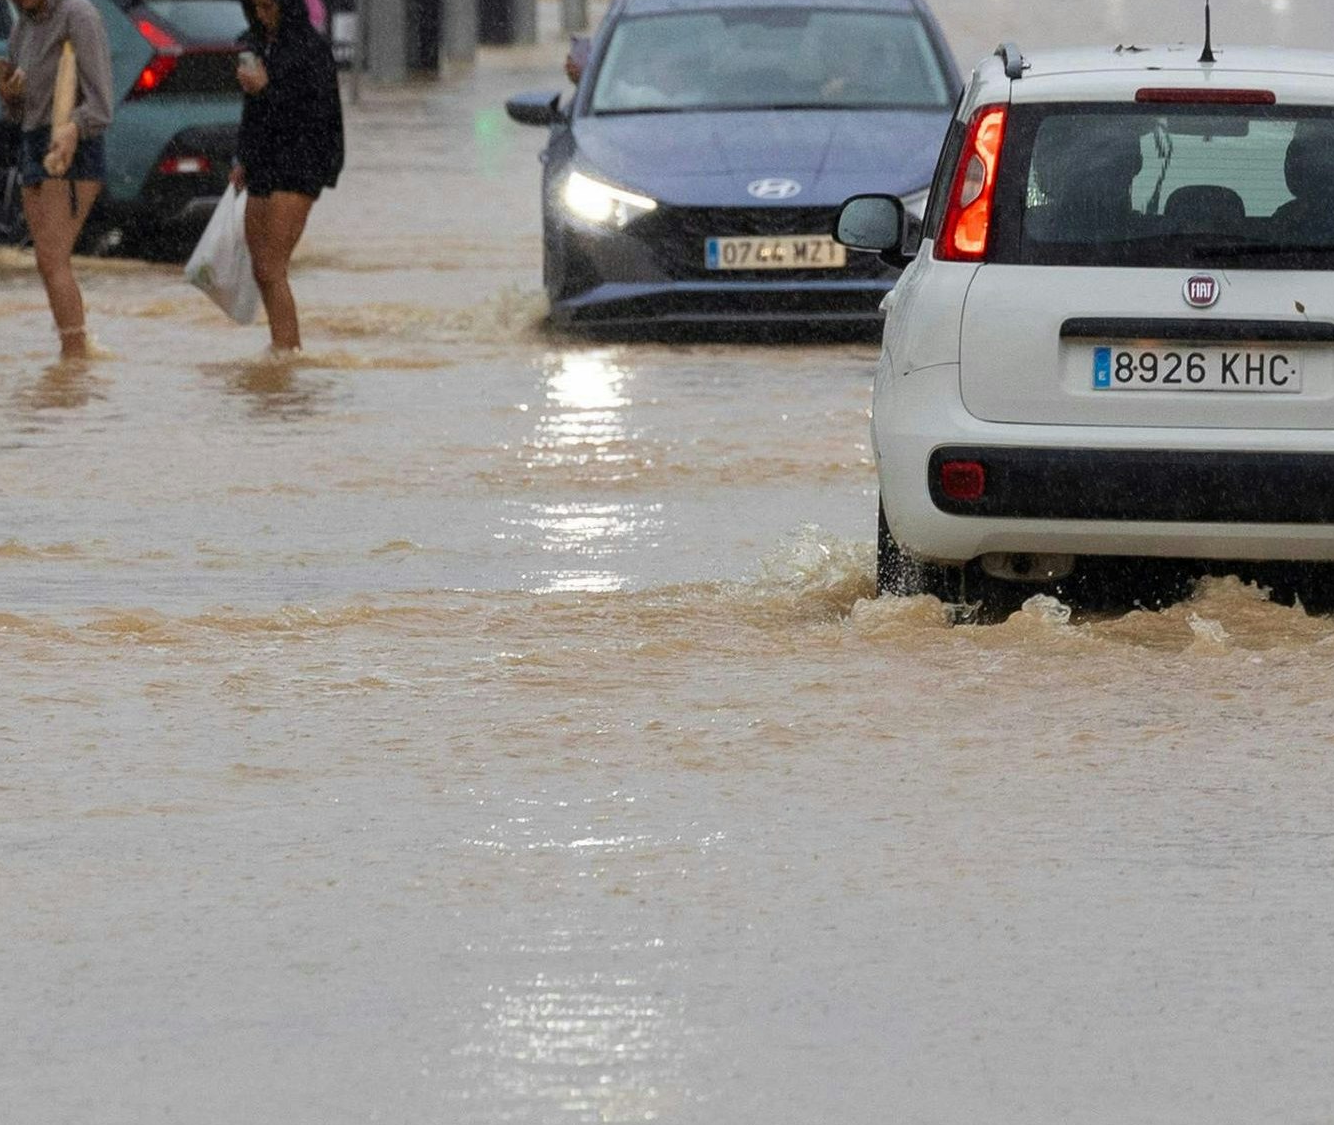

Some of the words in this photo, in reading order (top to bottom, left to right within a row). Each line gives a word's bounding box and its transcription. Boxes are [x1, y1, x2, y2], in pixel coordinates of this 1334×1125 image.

[1190, 281, 1214, 299] FIAT
[1114, 351, 1206, 384] 8926
[1220, 352, 1289, 386] KHC
